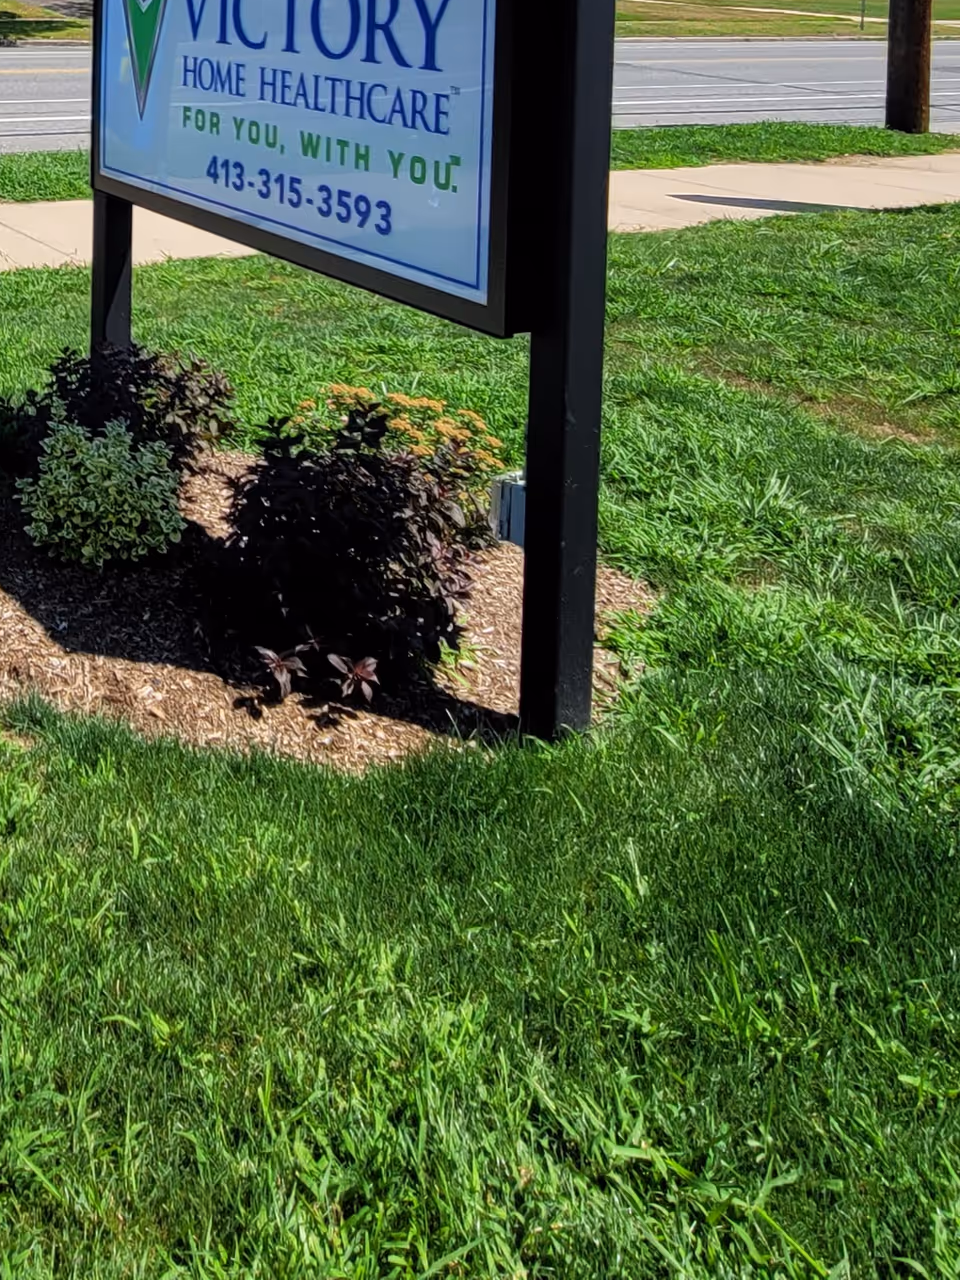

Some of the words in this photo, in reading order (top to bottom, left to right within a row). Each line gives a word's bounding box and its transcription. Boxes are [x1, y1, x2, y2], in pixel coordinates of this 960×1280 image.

[182, 55, 246, 98] HOME
[182, 105, 221, 136] FOR
[232, 116, 286, 155] YOU,
[299, 130, 371, 172] WITH
[206, 154, 392, 236] 413-315-3593
